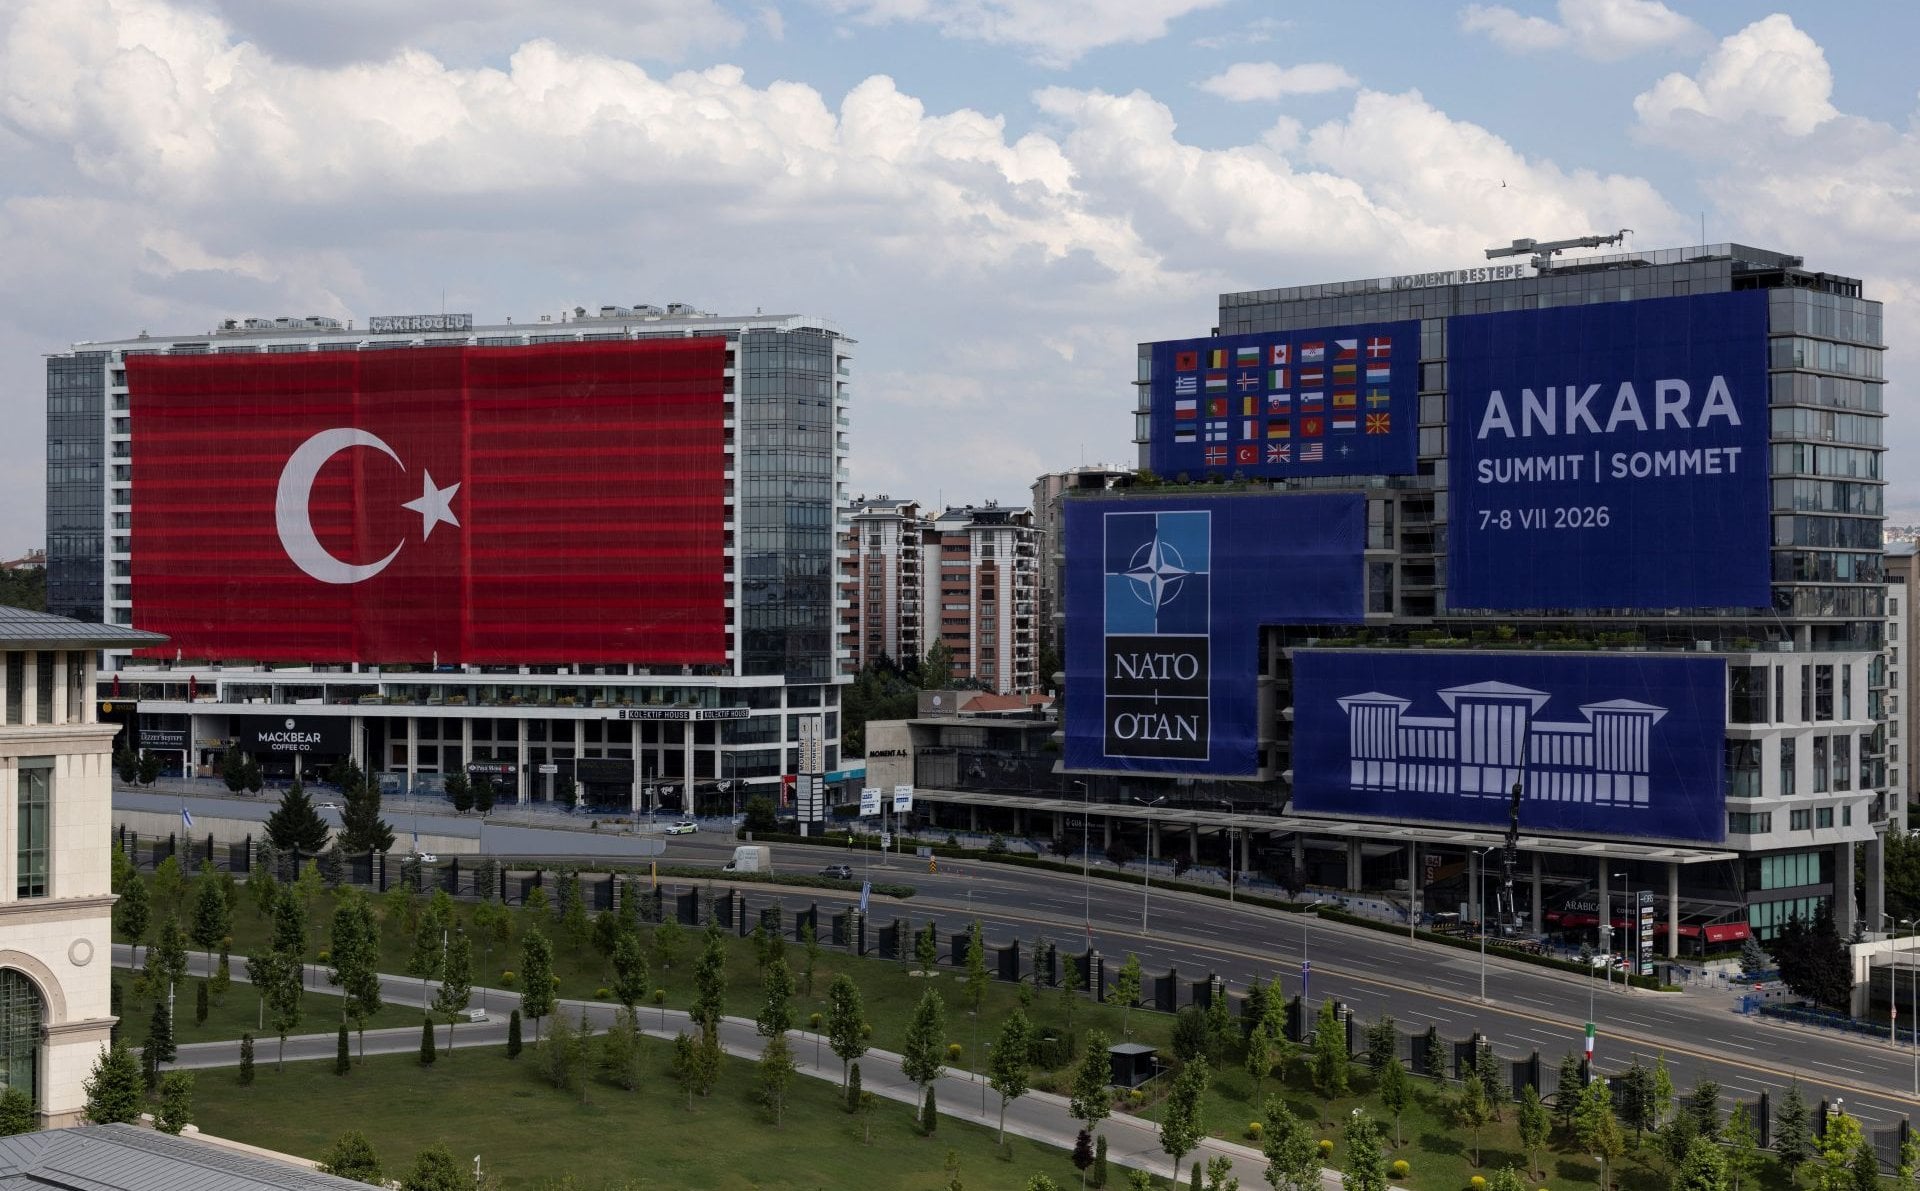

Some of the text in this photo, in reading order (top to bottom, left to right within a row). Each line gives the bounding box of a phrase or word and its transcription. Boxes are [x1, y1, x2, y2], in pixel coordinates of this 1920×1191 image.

[1392, 271, 1454, 289] MOMENT
[1477, 375, 1742, 439] ANKARA
[1477, 454, 1584, 483] SUMMIT
[1611, 447, 1742, 478] SOMMET
[1479, 506, 1610, 530] 7-8 VII 2026
[1114, 652, 1199, 680] NATO
[664, 711, 688, 719] HOUSE
[731, 709, 750, 718] HOUSE
[1114, 712, 1199, 741] OTAN
[258, 731, 321, 743] MACKBEAR
[271, 743, 298, 751] COFFEE
[869, 750, 896, 758] MOMENT
